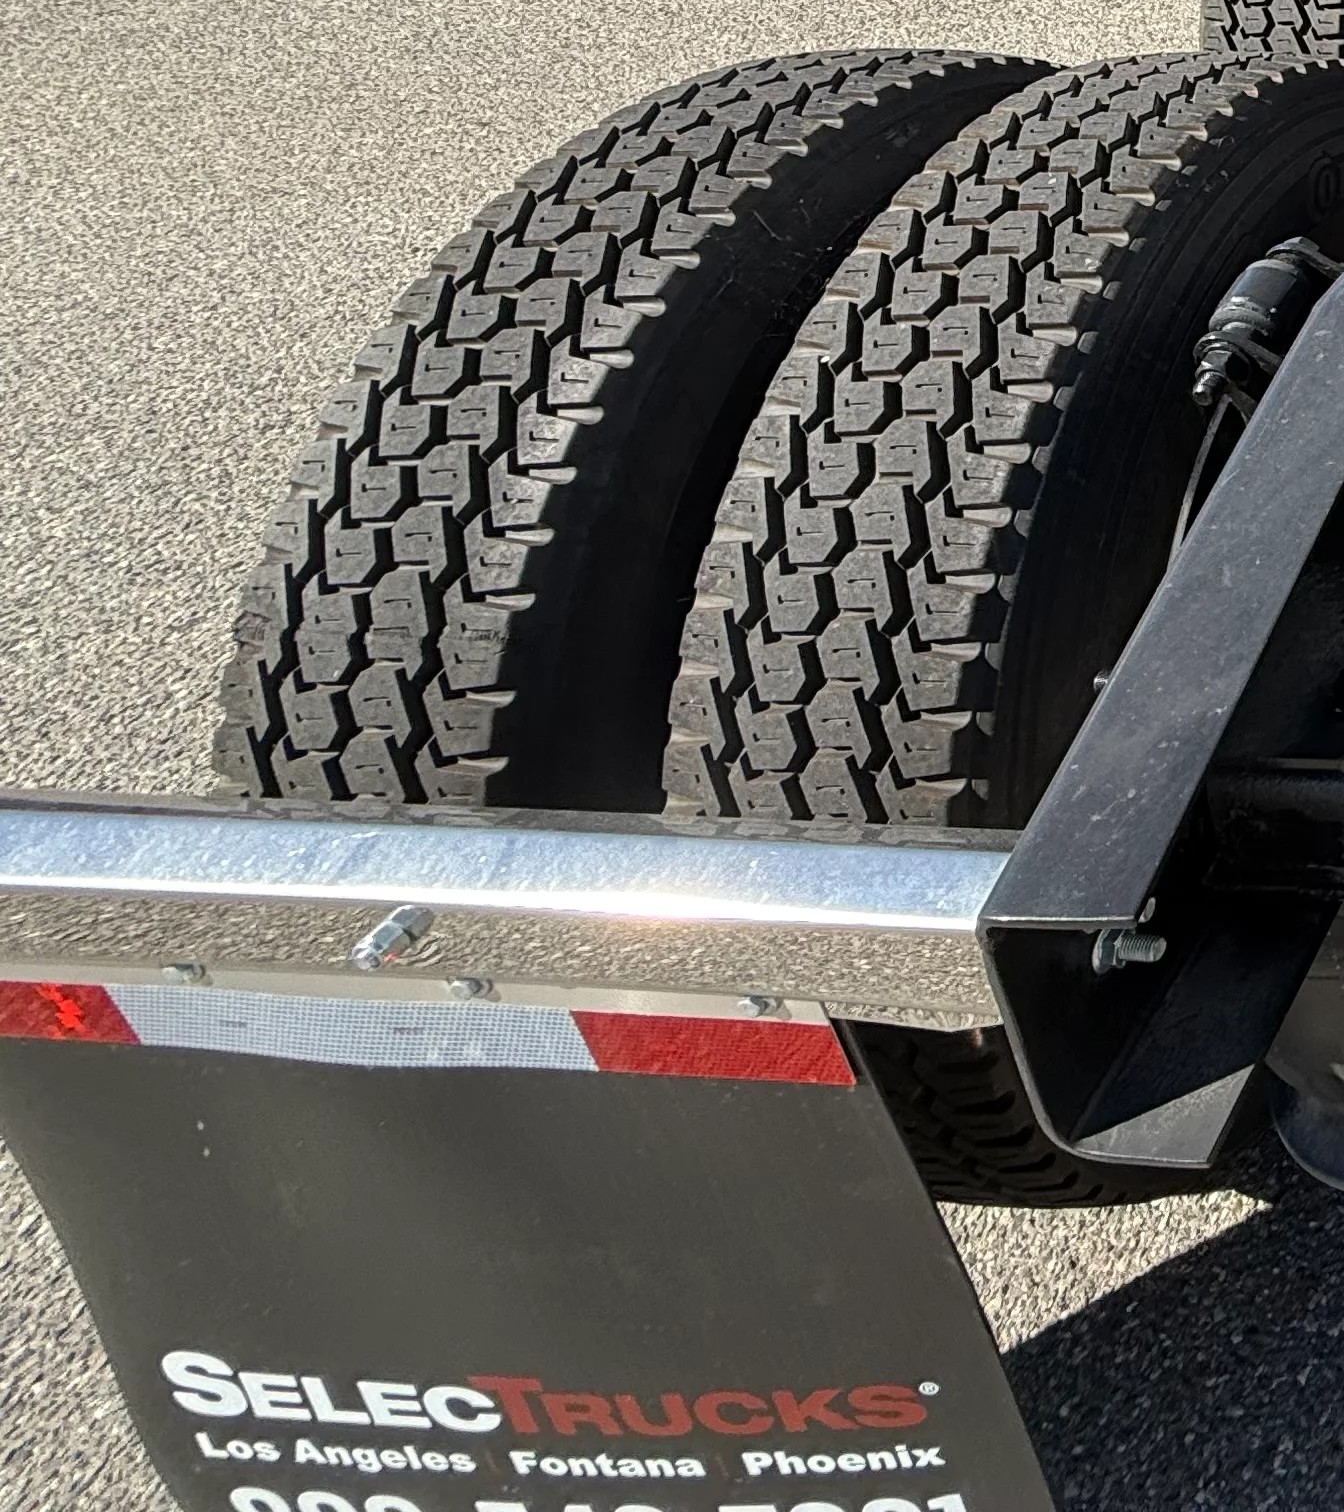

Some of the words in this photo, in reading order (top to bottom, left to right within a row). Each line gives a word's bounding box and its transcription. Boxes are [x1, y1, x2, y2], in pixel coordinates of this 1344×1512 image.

[195, 1430, 281, 1463] Los
[294, 1437, 478, 1474] Angeles
[508, 1449, 706, 1479] Fontana
[740, 1443, 947, 1477] Phoenix
